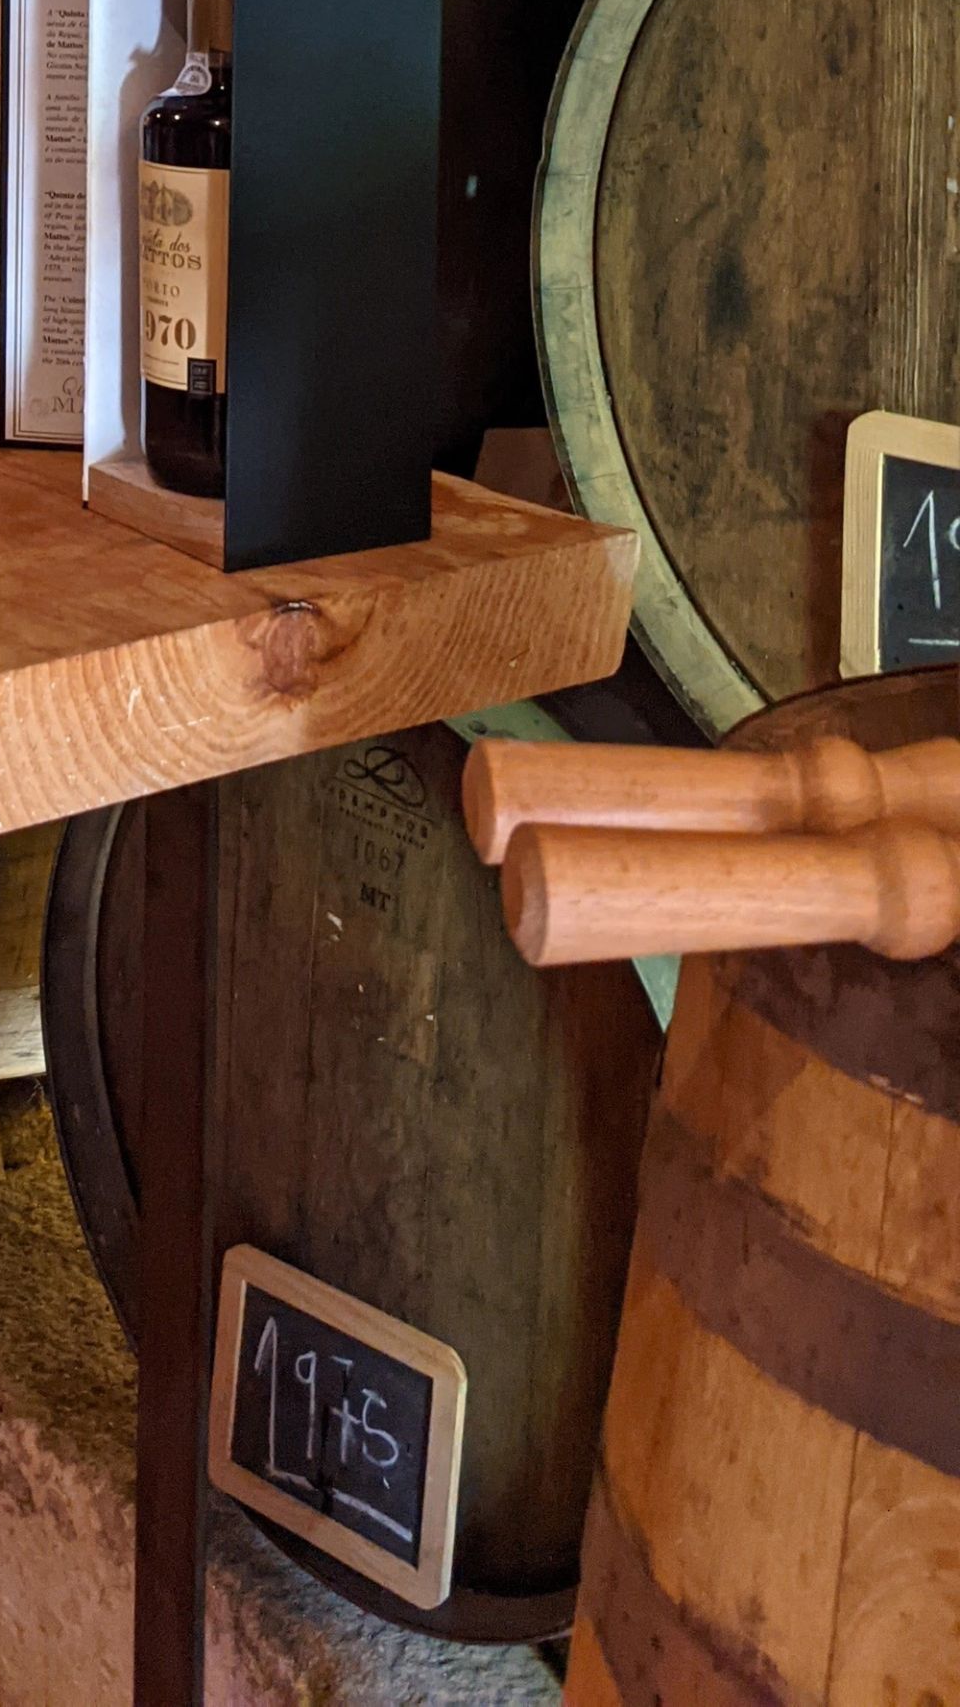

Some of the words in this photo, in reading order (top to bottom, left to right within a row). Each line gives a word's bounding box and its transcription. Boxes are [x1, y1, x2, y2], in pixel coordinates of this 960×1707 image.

[142, 244, 202, 271] ATTOS
[168, 230, 191, 253] dos
[145, 309, 197, 351] 970
[253, 1315, 400, 1474] 1975
